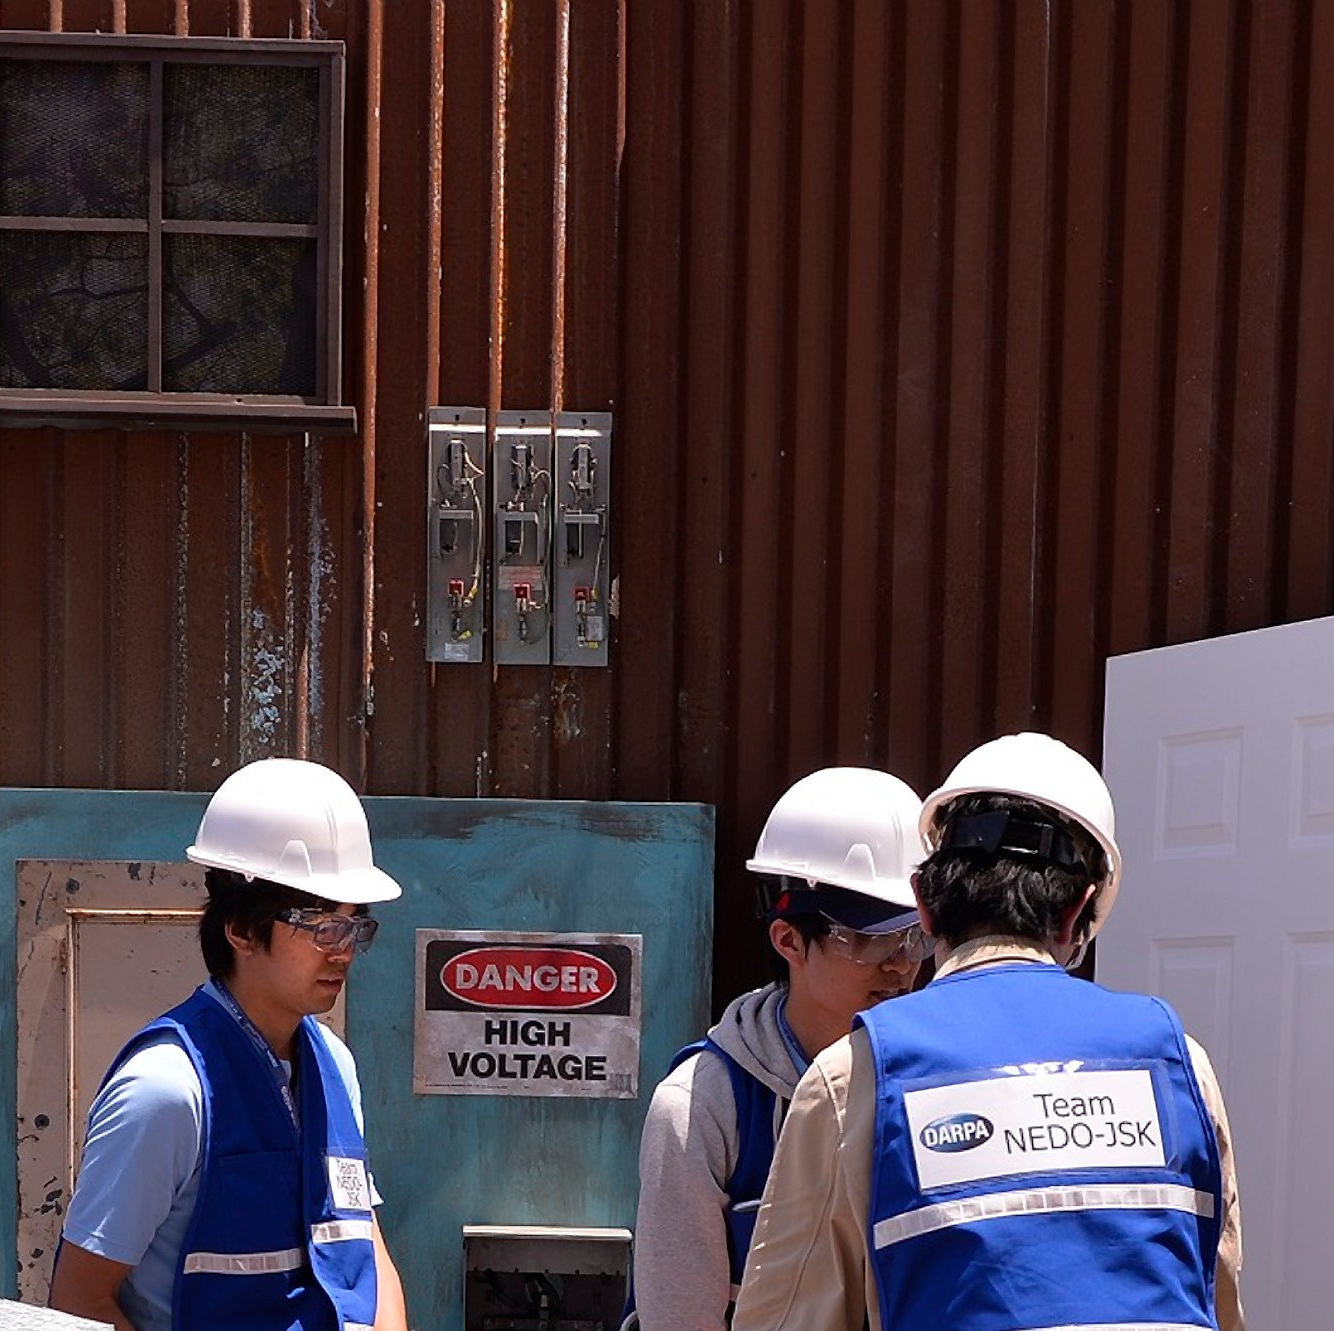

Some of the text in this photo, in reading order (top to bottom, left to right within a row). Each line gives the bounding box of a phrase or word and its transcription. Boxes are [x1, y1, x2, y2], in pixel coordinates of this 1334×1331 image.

[455, 963, 601, 994] DANGER
[484, 1020, 571, 1047] HIGH
[448, 1052, 607, 1081] VOLTAGE
[1033, 1093, 1115, 1118] Team
[924, 1119, 990, 1148] DARPA
[1004, 1120, 1156, 1154] NEDO-JSK
